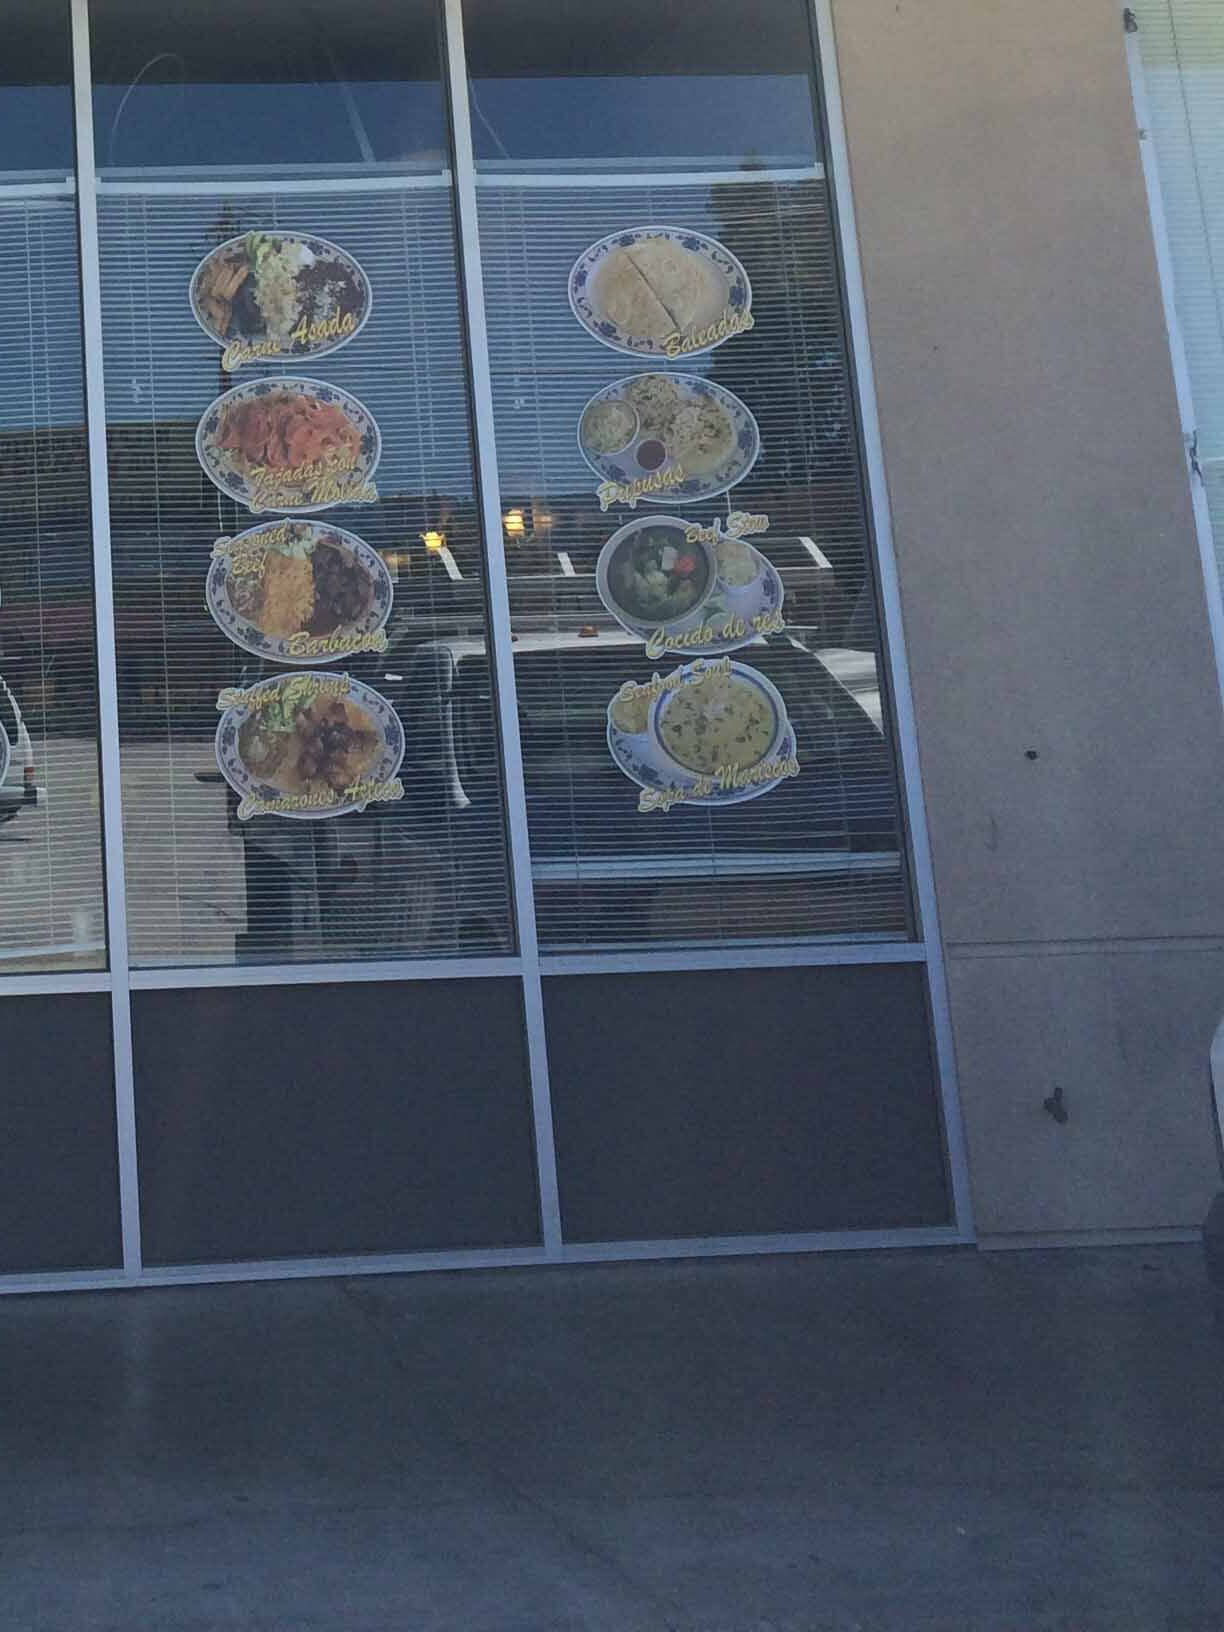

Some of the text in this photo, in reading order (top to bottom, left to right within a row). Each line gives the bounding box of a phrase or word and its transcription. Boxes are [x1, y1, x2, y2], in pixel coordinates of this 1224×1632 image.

[289, 306, 356, 345] Asada
[663, 311, 754, 358] Baleadas
[598, 465, 687, 511] Pupusas
[646, 622, 714, 659] Cocido
[722, 614, 746, 639] de
